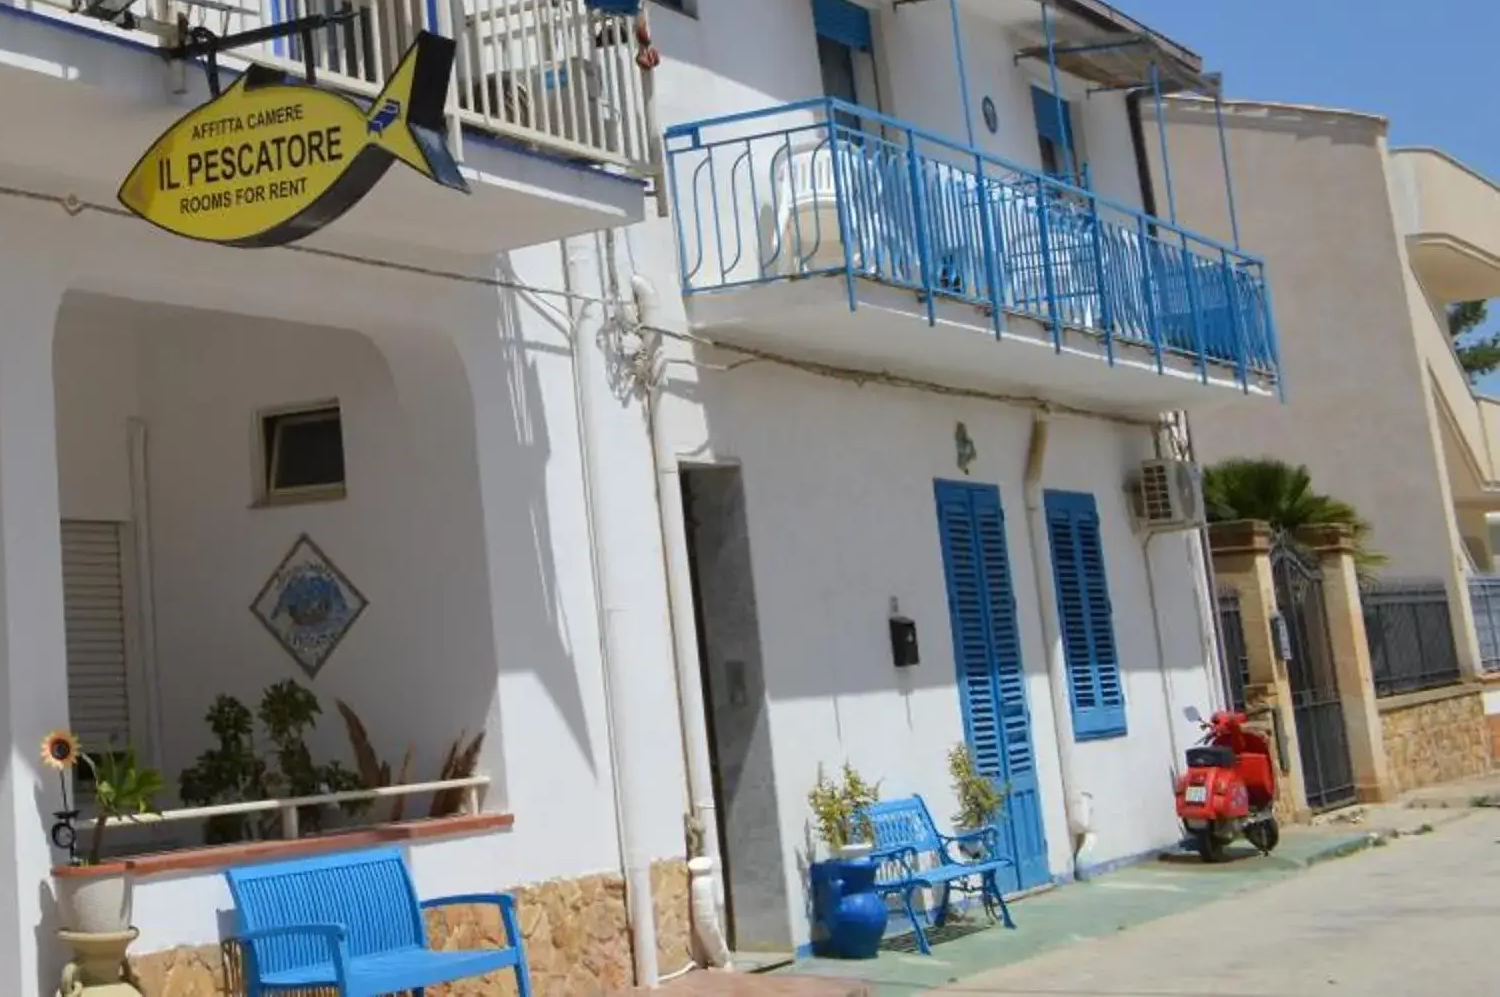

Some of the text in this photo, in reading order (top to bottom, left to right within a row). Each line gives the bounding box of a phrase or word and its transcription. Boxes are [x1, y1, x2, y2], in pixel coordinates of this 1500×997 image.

[191, 104, 304, 140] AFFITTA CAMERE
[158, 126, 342, 191] IL PESCATORE
[180, 177, 308, 214] ROOMS FOR RENT
